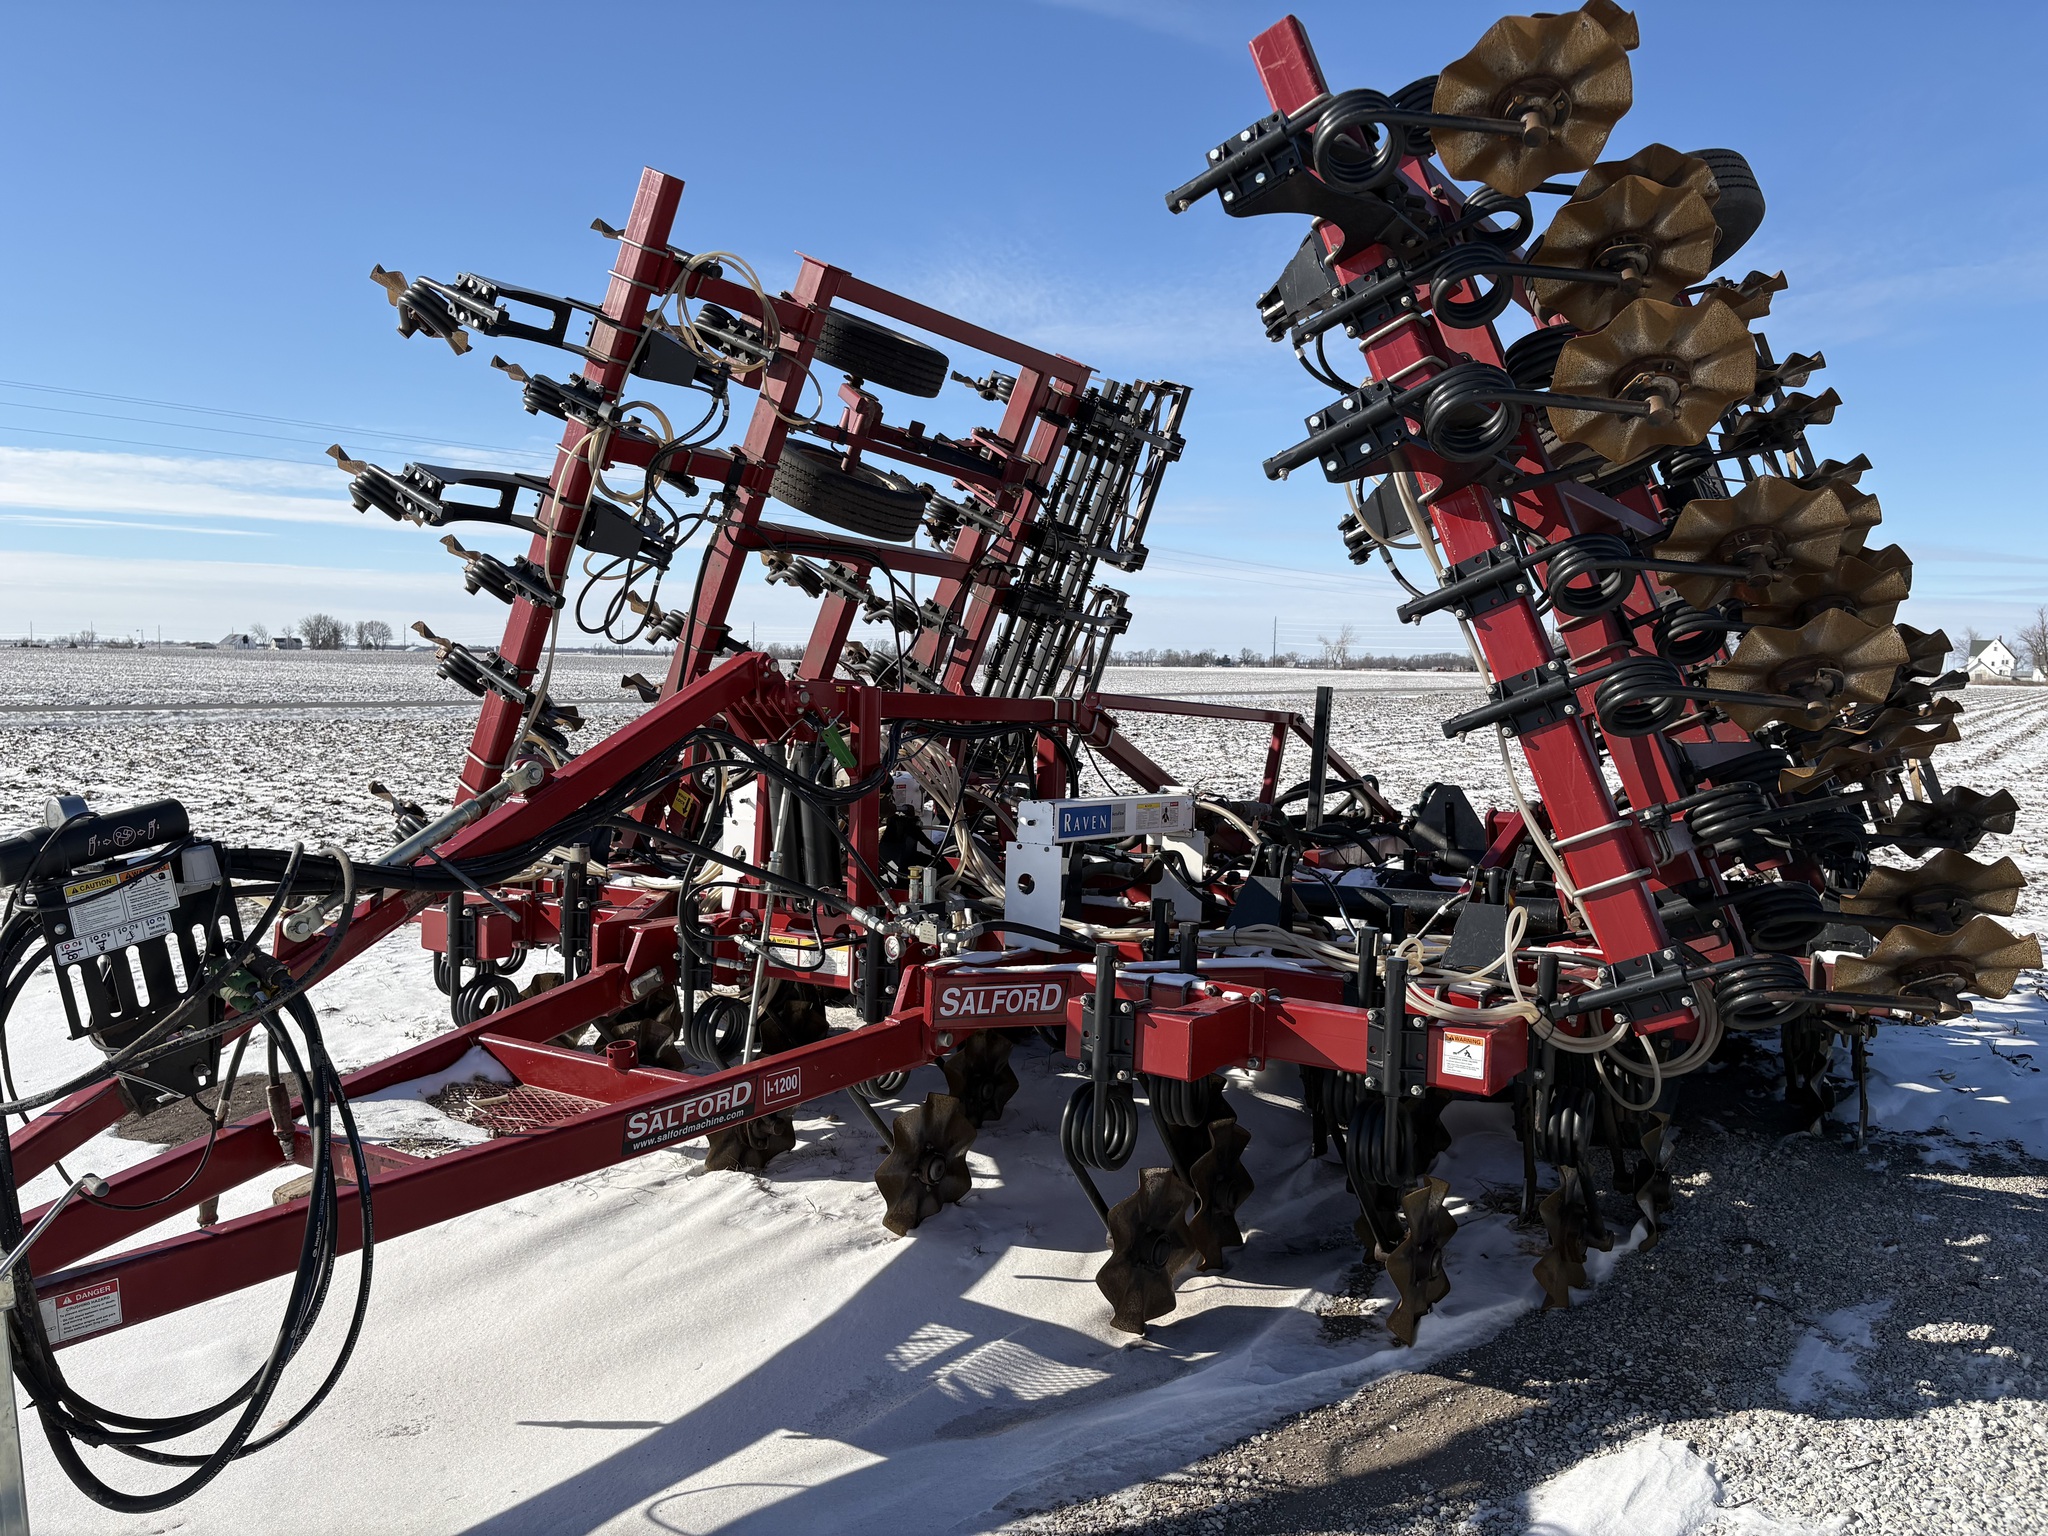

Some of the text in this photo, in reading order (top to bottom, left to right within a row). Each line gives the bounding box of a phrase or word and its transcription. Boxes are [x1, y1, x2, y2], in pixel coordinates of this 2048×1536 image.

[1064, 814, 1106, 832] RAVEN
[80, 878, 112, 891] CAUTION
[940, 984, 1062, 1016] SALFORD
[1455, 1036, 1481, 1045] WARNING
[767, 1074, 797, 1096] I-1200
[627, 1082, 752, 1139] SALFORD
[633, 1109, 744, 1150] www.salfordmachine.com
[76, 1285, 111, 1300] DANGER
[66, 1296, 110, 1312] CRUSHING HAZARD
